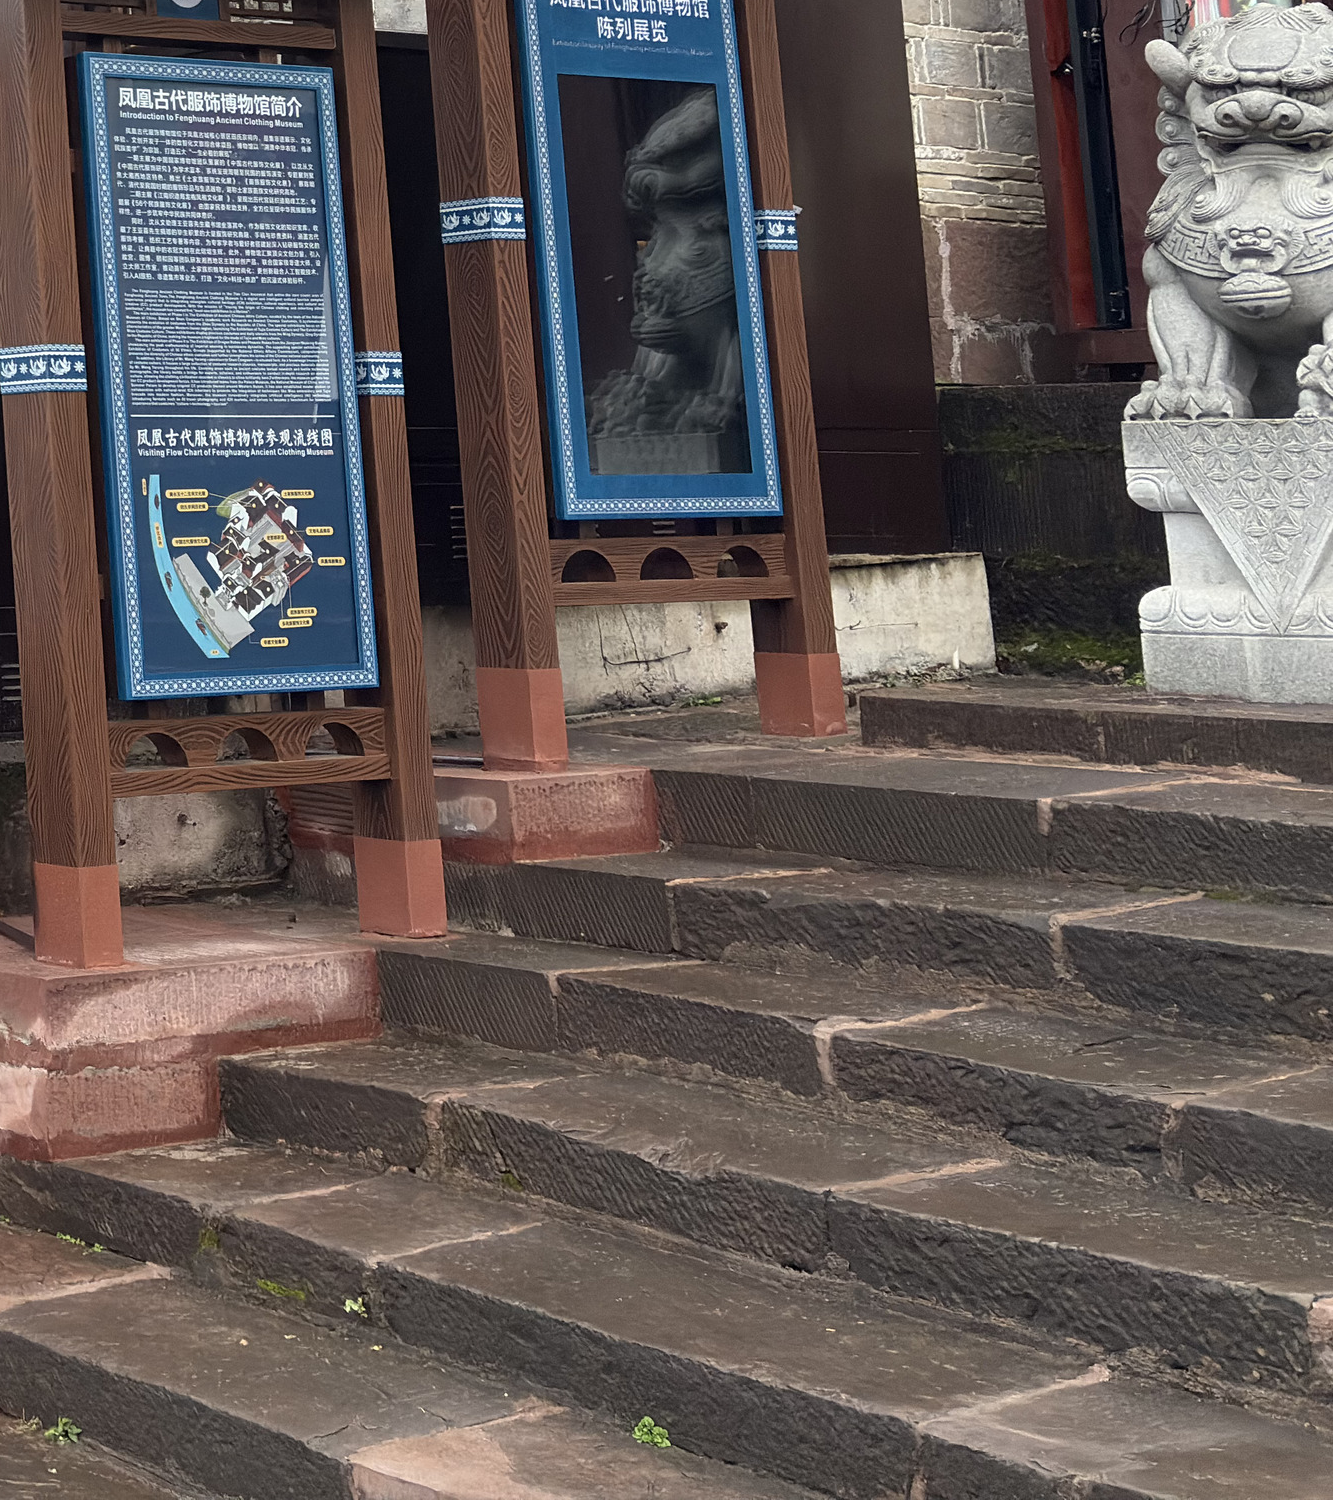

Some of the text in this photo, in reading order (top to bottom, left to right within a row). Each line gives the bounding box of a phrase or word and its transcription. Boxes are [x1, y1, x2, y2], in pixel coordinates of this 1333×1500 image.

[597, 17, 668, 43] 陈列展览
[118, 88, 303, 118] 凤凰古代服饰博物馆简介
[120, 110, 304, 128] Introduction to Fenghuang Ancient Clothing Museum
[137, 428, 333, 447] 凤凰古代服饰博物馆参观流线图
[138, 448, 334, 458] Visiting Flow Chart of Fenghuang Ancient Clothing Museum
